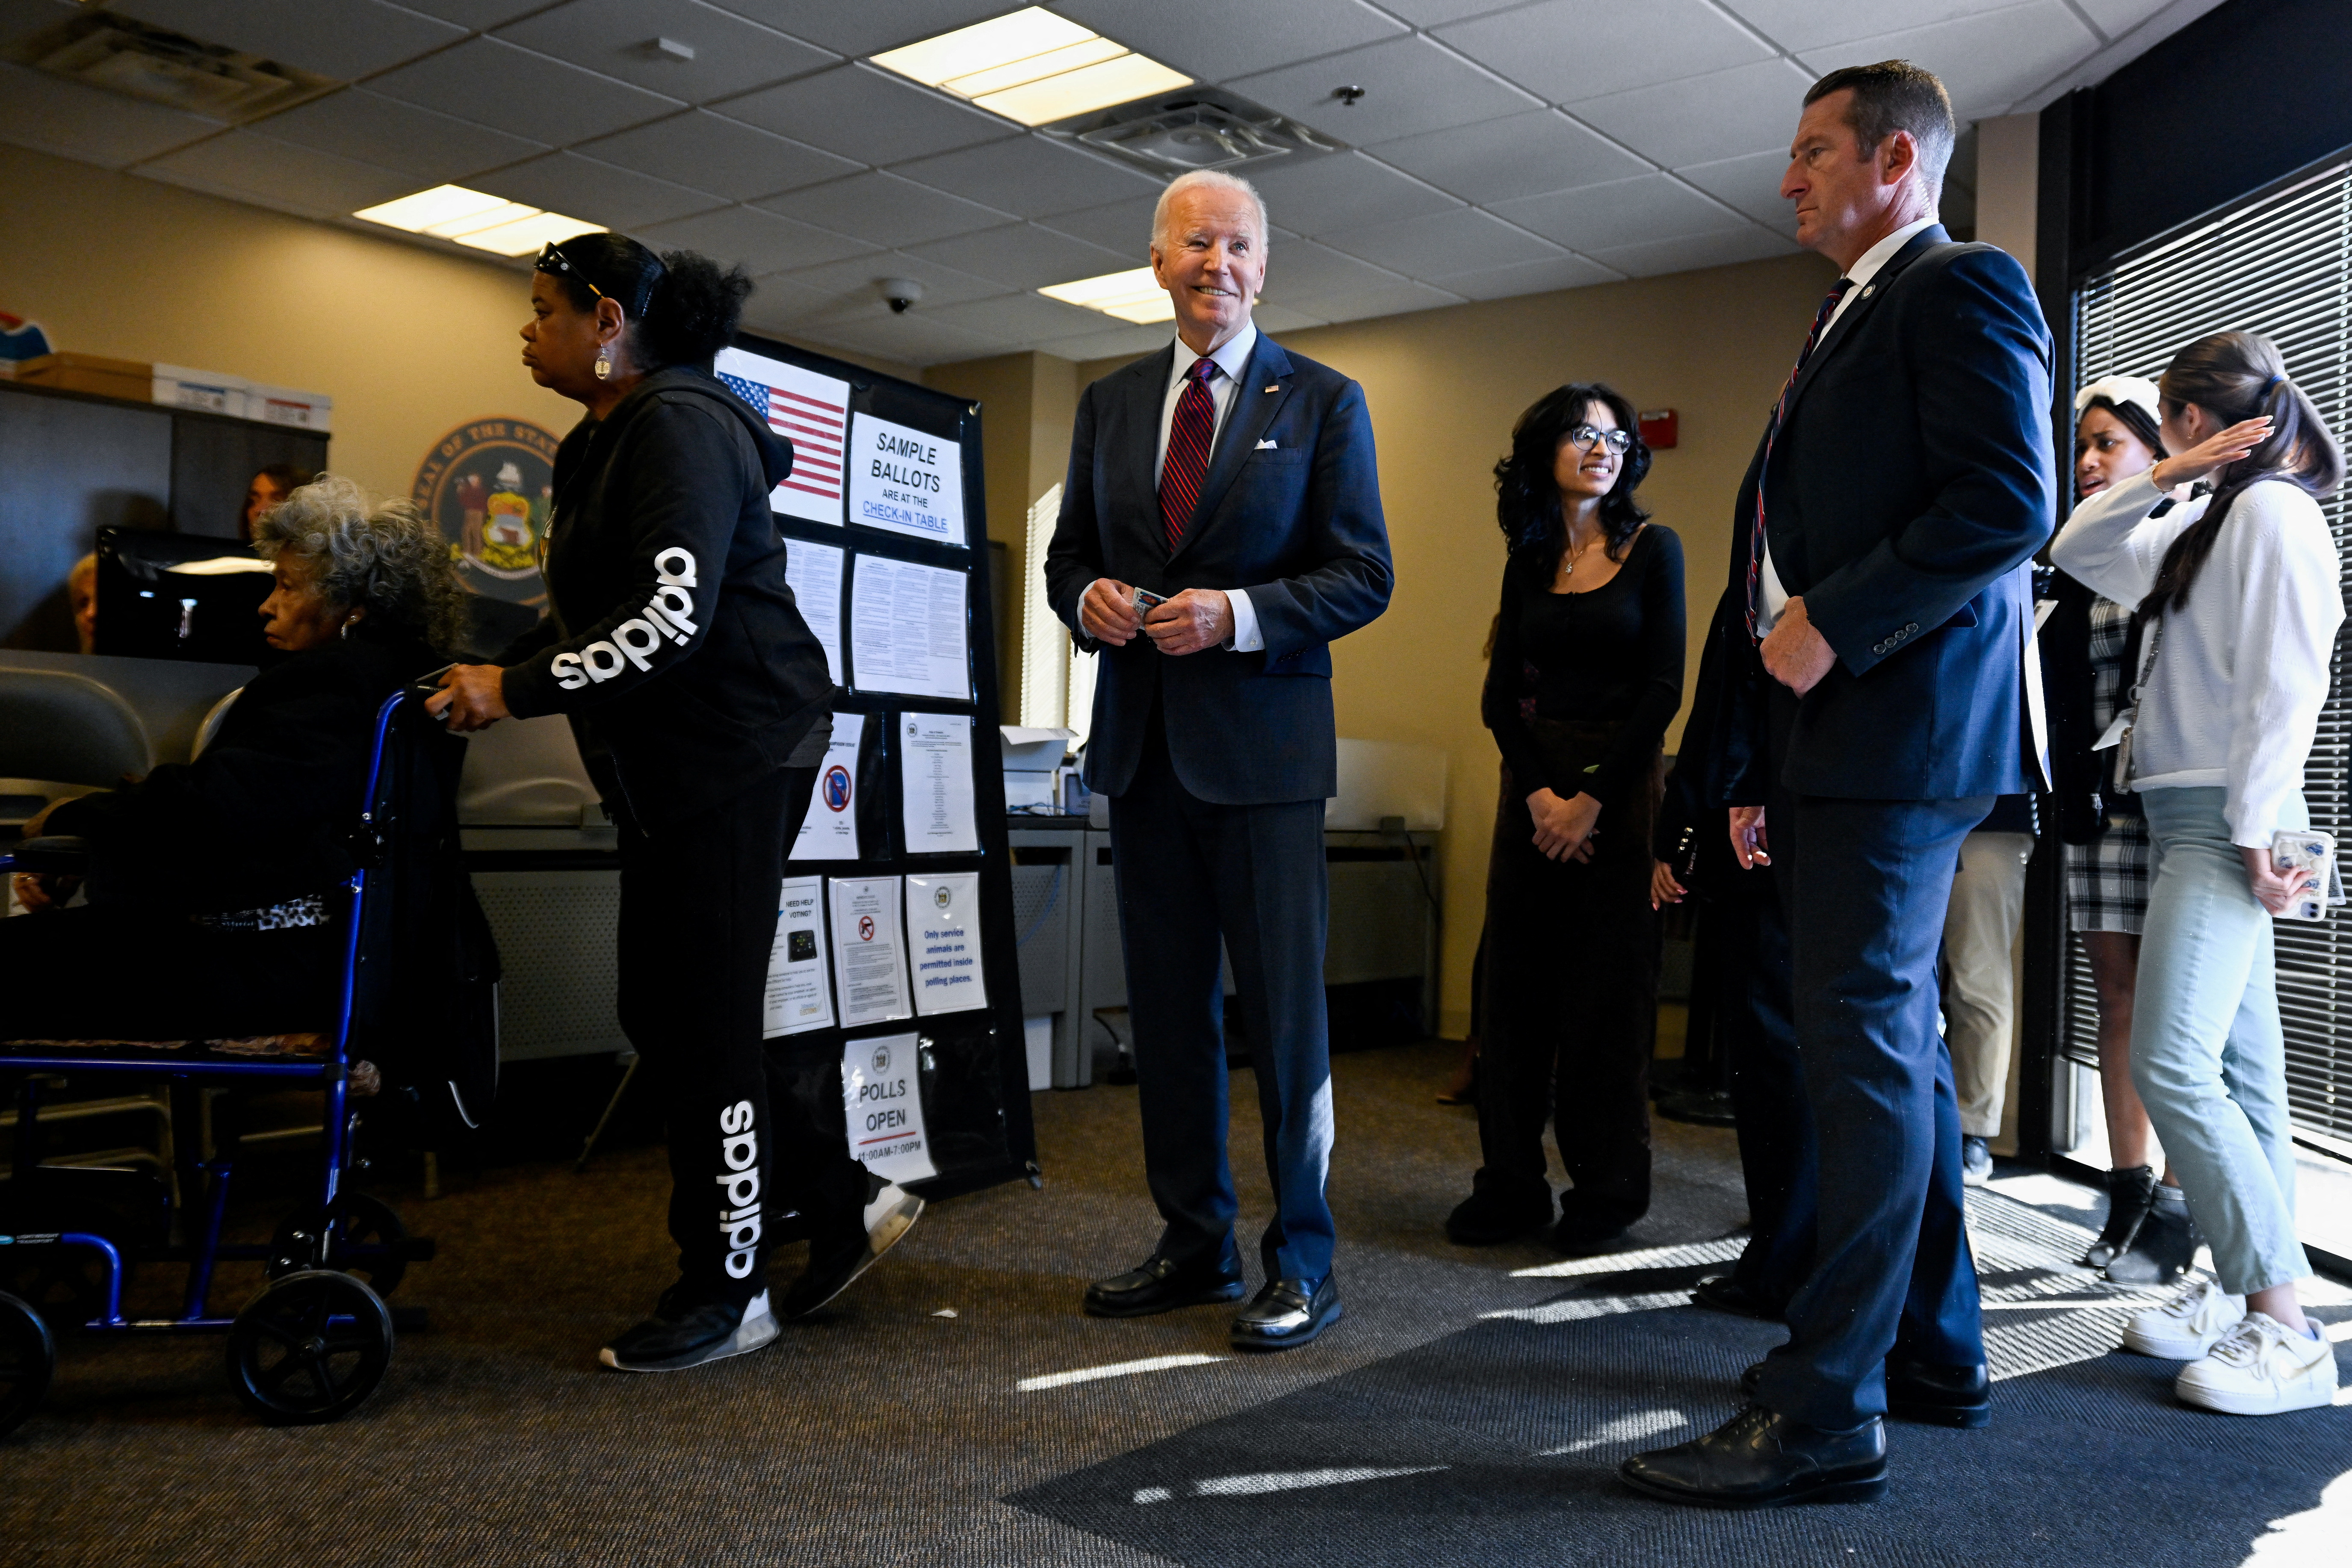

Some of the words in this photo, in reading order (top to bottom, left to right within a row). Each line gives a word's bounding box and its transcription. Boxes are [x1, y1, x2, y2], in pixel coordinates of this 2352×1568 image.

[441, 435, 463, 458] OF
[876, 432, 937, 465] SAMPLE
[871, 458, 940, 493] BALLOTS
[882, 488, 898, 502] ARE
[901, 493, 910, 504] AT
[913, 496, 928, 508] THE
[863, 500, 912, 523] CHECK-IN
[914, 512, 948, 531] TABLE
[551, 546, 698, 690] adidas
[789, 910, 812, 918] VOTING?
[924, 930, 939, 939] Only
[940, 929, 964, 938] service
[926, 944, 952, 954] animals
[919, 959, 952, 972] permitted
[953, 957, 973, 966] inside
[925, 977, 948, 988] polling
[949, 975, 972, 985] places.
[859, 1079, 906, 1104] POLLS
[866, 1108, 906, 1132] OPEN
[716, 1100, 761, 1279] adidas
